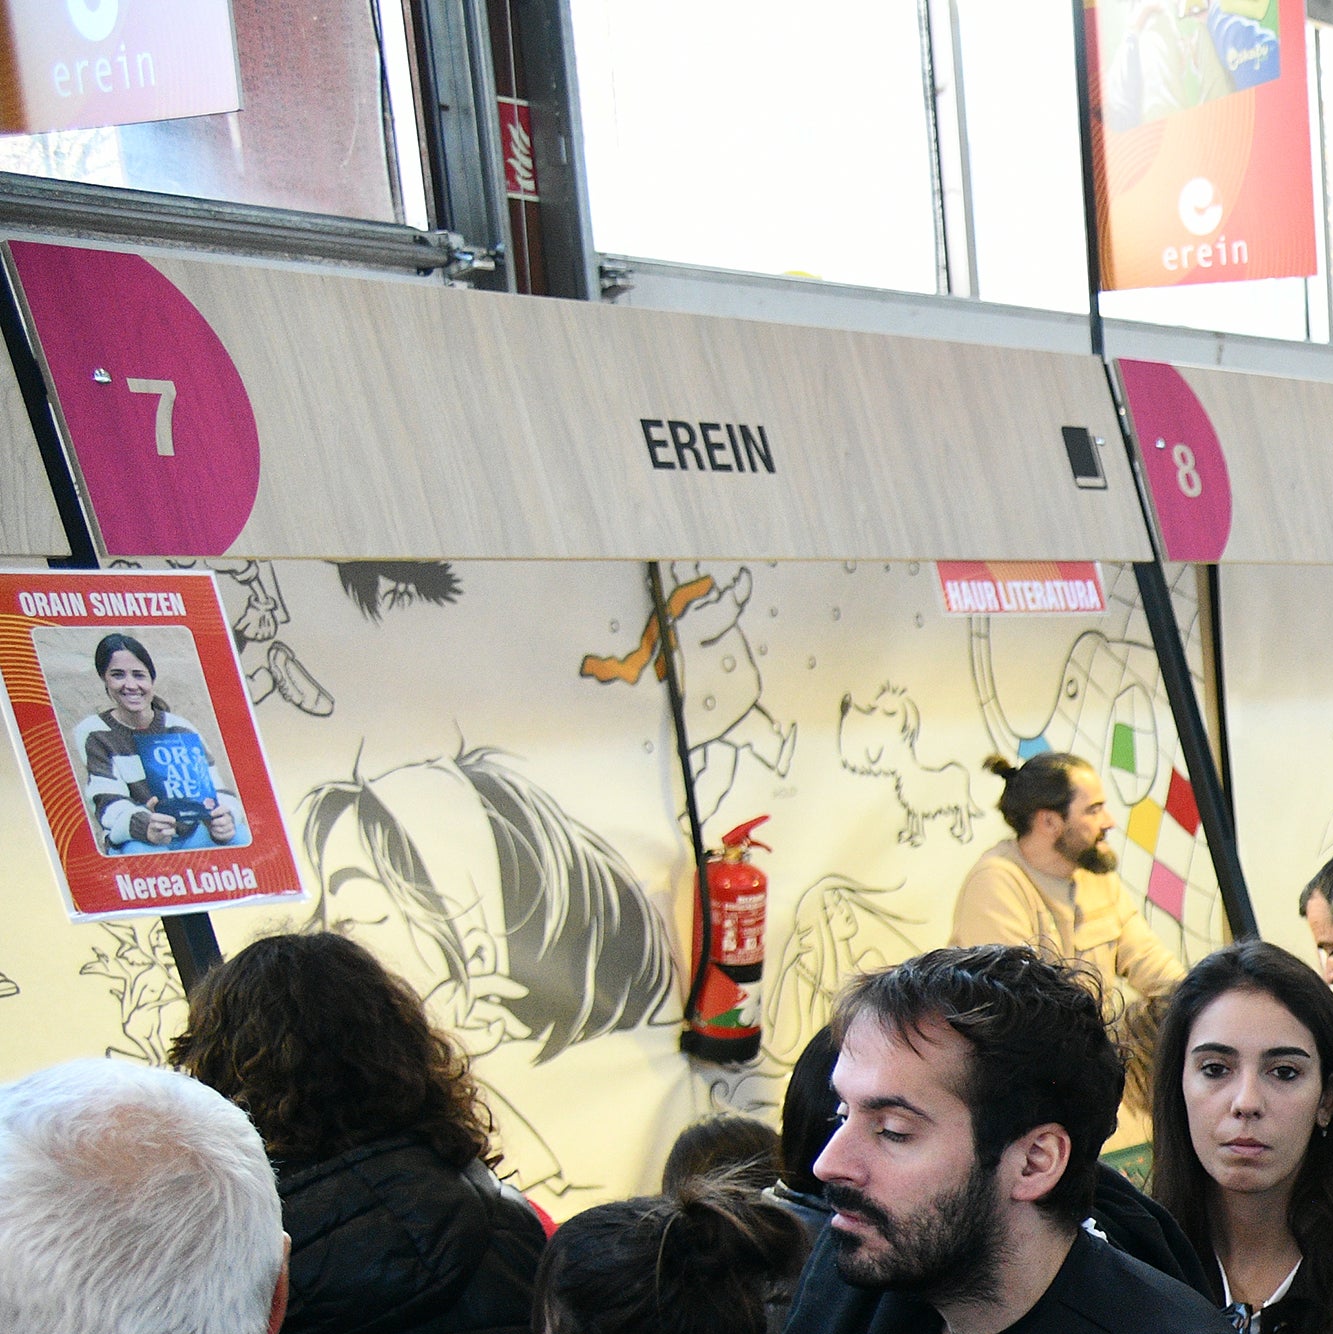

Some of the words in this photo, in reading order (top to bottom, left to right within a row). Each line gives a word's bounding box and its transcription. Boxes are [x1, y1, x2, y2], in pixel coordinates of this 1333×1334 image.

[53, 43, 156, 97] erein
[1162, 235, 1249, 271] erein
[126, 378, 177, 456] 7
[639, 418, 776, 475] EREIN
[1172, 443, 1202, 498] 8
[18, 592, 88, 617] ORAIN
[89, 592, 187, 617] SINATZEN
[945, 579, 1000, 611] HAUR
[999, 579, 1102, 611] LITERATURA
[115, 873, 187, 901] Nerea
[185, 863, 258, 895] Loiola
